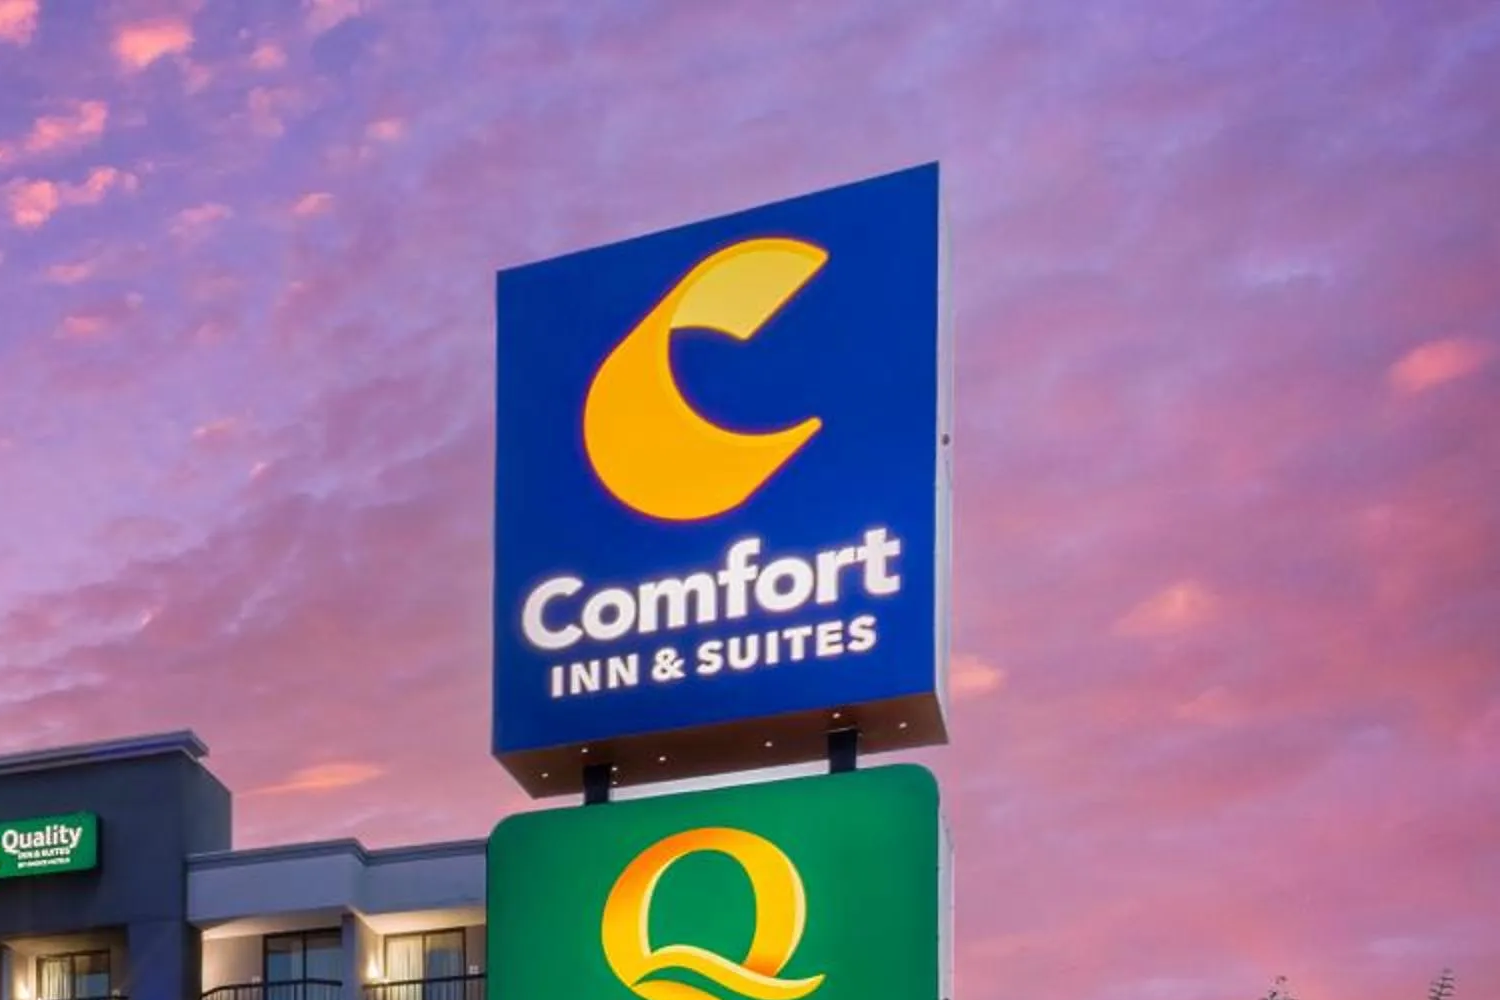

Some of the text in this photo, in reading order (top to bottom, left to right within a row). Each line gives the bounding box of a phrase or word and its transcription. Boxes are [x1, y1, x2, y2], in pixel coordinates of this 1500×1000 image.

[521, 527, 902, 650] Comfort
[551, 615, 878, 698] INN & SUITES
[1, 824, 83, 855] Quality
